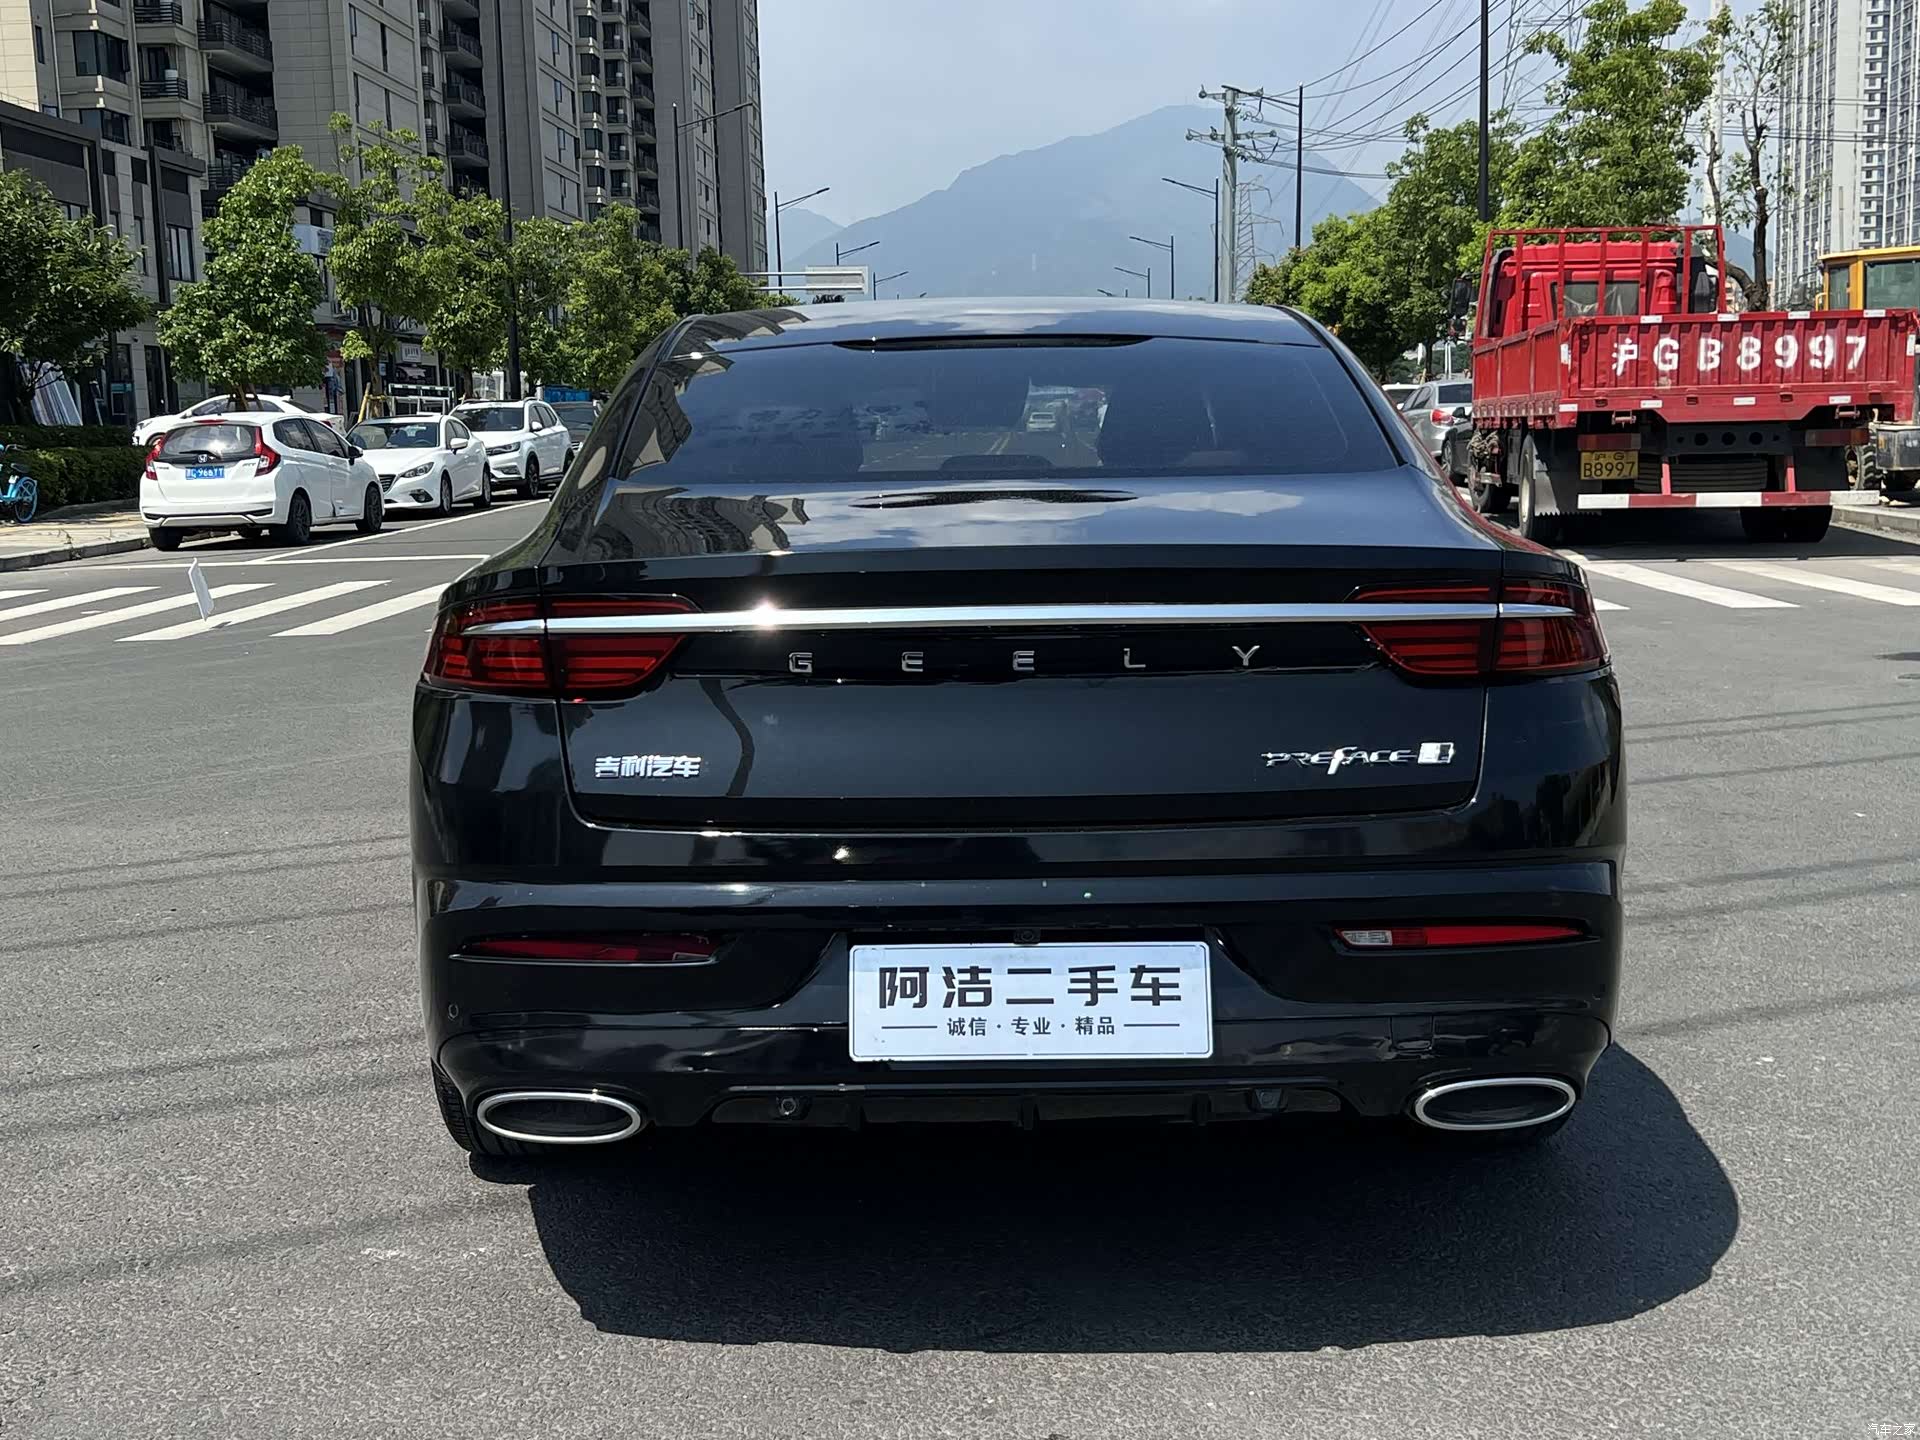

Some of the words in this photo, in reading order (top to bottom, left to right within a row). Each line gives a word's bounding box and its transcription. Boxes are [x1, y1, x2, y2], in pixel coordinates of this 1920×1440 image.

[1583, 462, 1636, 478] B8997
[788, 644, 1261, 673] GEELY
[595, 755, 701, 778] 吉利汽车
[879, 965, 1182, 1009] 阿洁二手车
